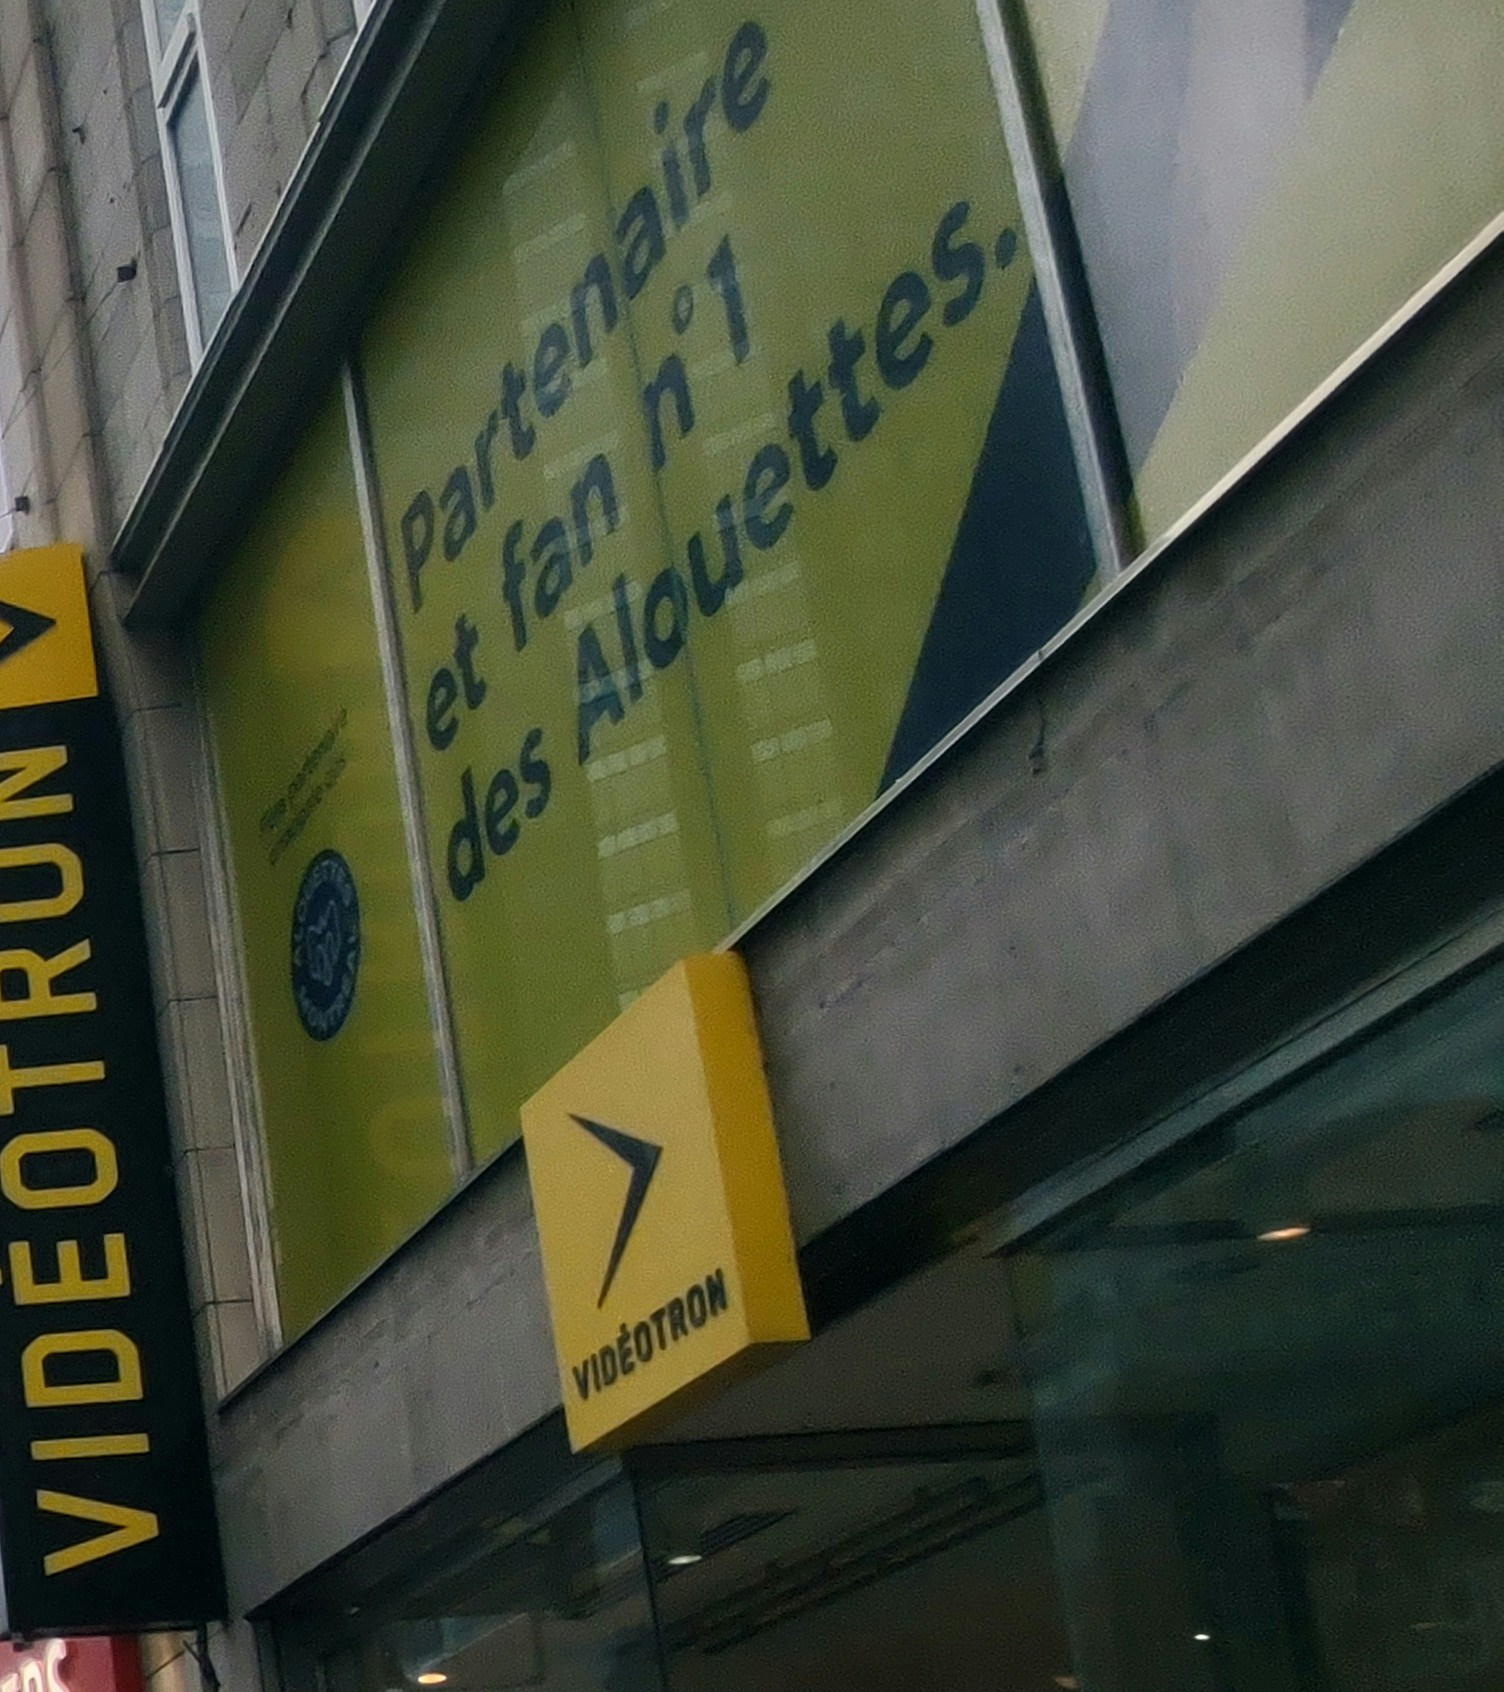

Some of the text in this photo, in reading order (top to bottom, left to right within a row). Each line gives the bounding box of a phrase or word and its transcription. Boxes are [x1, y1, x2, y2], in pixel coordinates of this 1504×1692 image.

[399, 20, 771, 614] Partenaire
[426, 614, 488, 751] et
[501, 452, 620, 653] fan
[445, 200, 1018, 903] des Alouettes.
[571, 1268, 728, 1401] VIDÉOTRON
